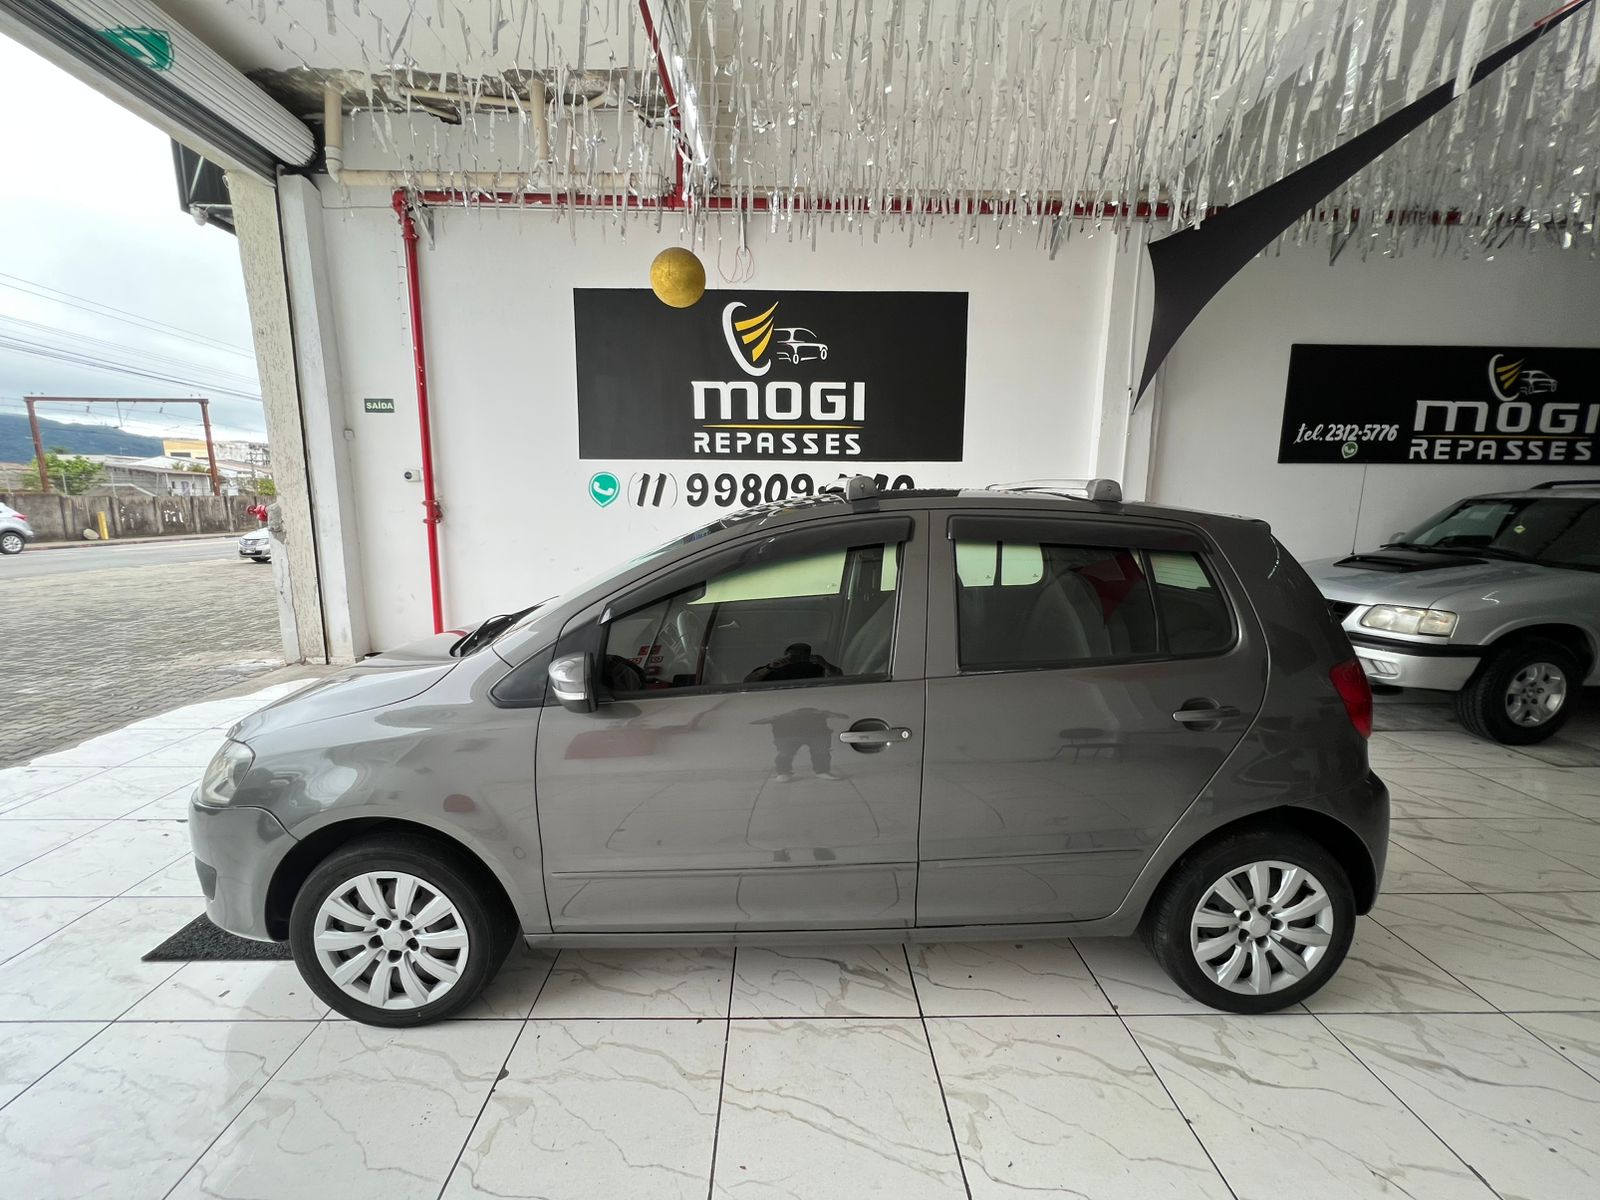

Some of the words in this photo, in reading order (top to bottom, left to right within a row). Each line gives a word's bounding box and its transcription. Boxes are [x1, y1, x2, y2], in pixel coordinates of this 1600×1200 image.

[691, 381, 866, 421] MOGI
[1413, 400, 1600, 434] MOGI
[693, 432, 862, 455] REPASSES
[1408, 439, 1592, 461] REPASSES
[627, 472, 679, 509] (11)
